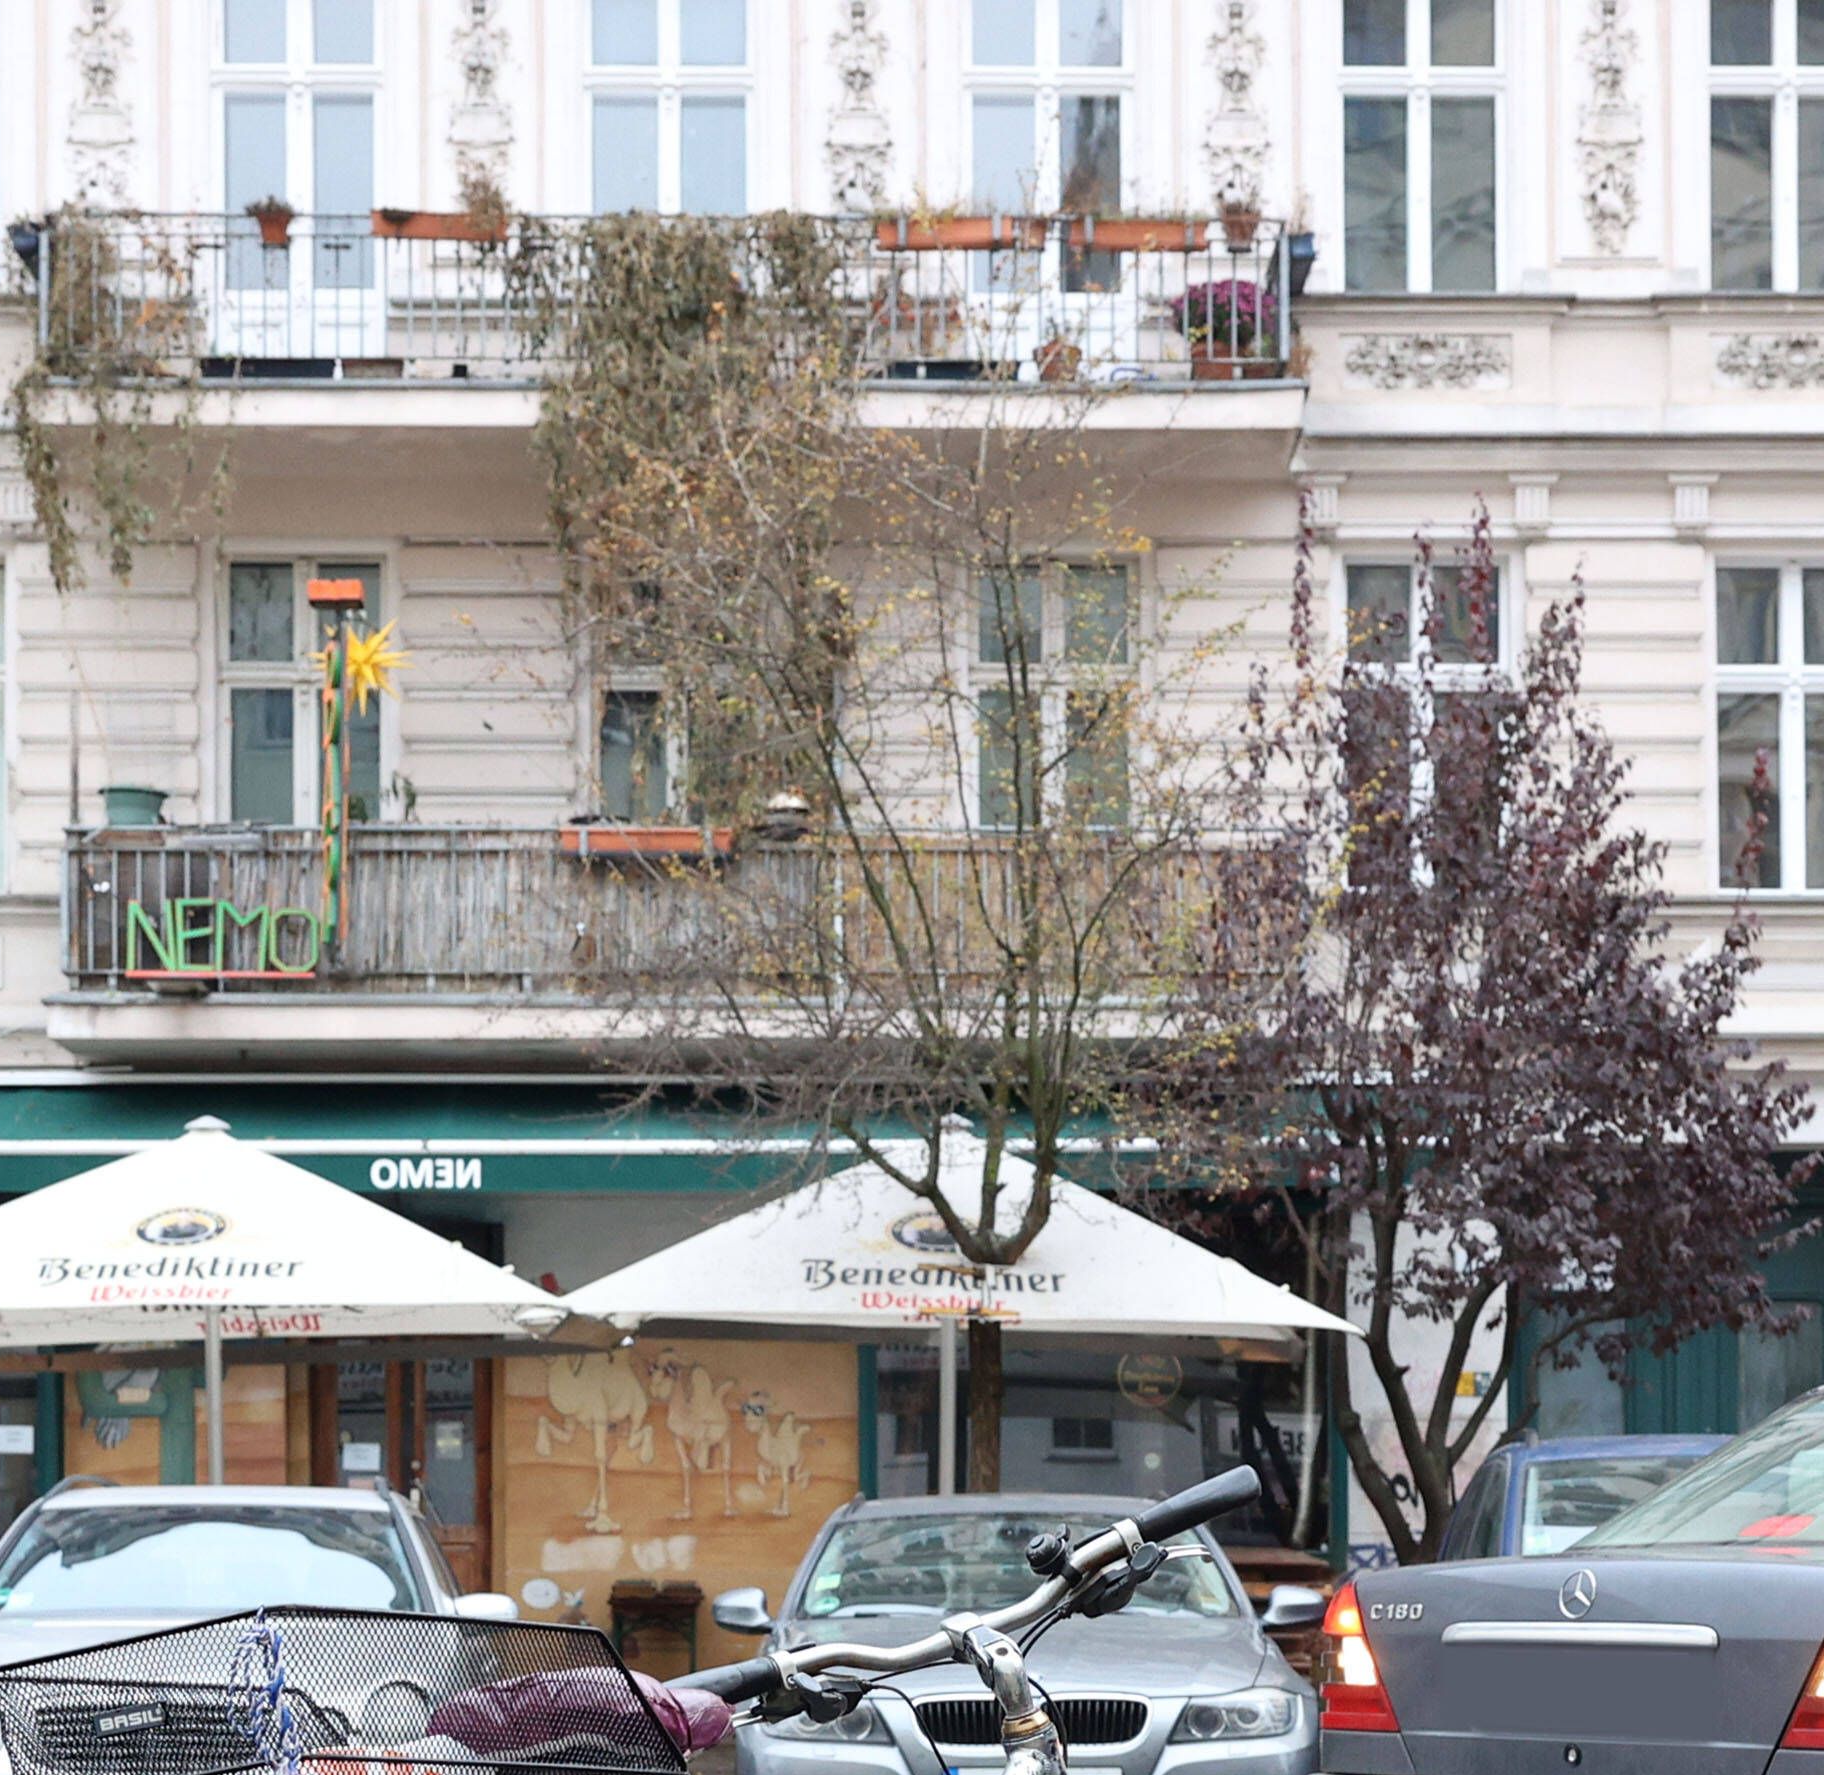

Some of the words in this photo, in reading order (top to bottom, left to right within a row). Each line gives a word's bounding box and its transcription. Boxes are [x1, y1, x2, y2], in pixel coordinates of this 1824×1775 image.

[126, 896, 320, 973] NEMO
[38, 1257, 304, 1286] Benediktiner
[90, 1286, 233, 1302] Weissbier
[1370, 1603, 1384, 1620] C
[99, 1709, 163, 1732] BASIL
